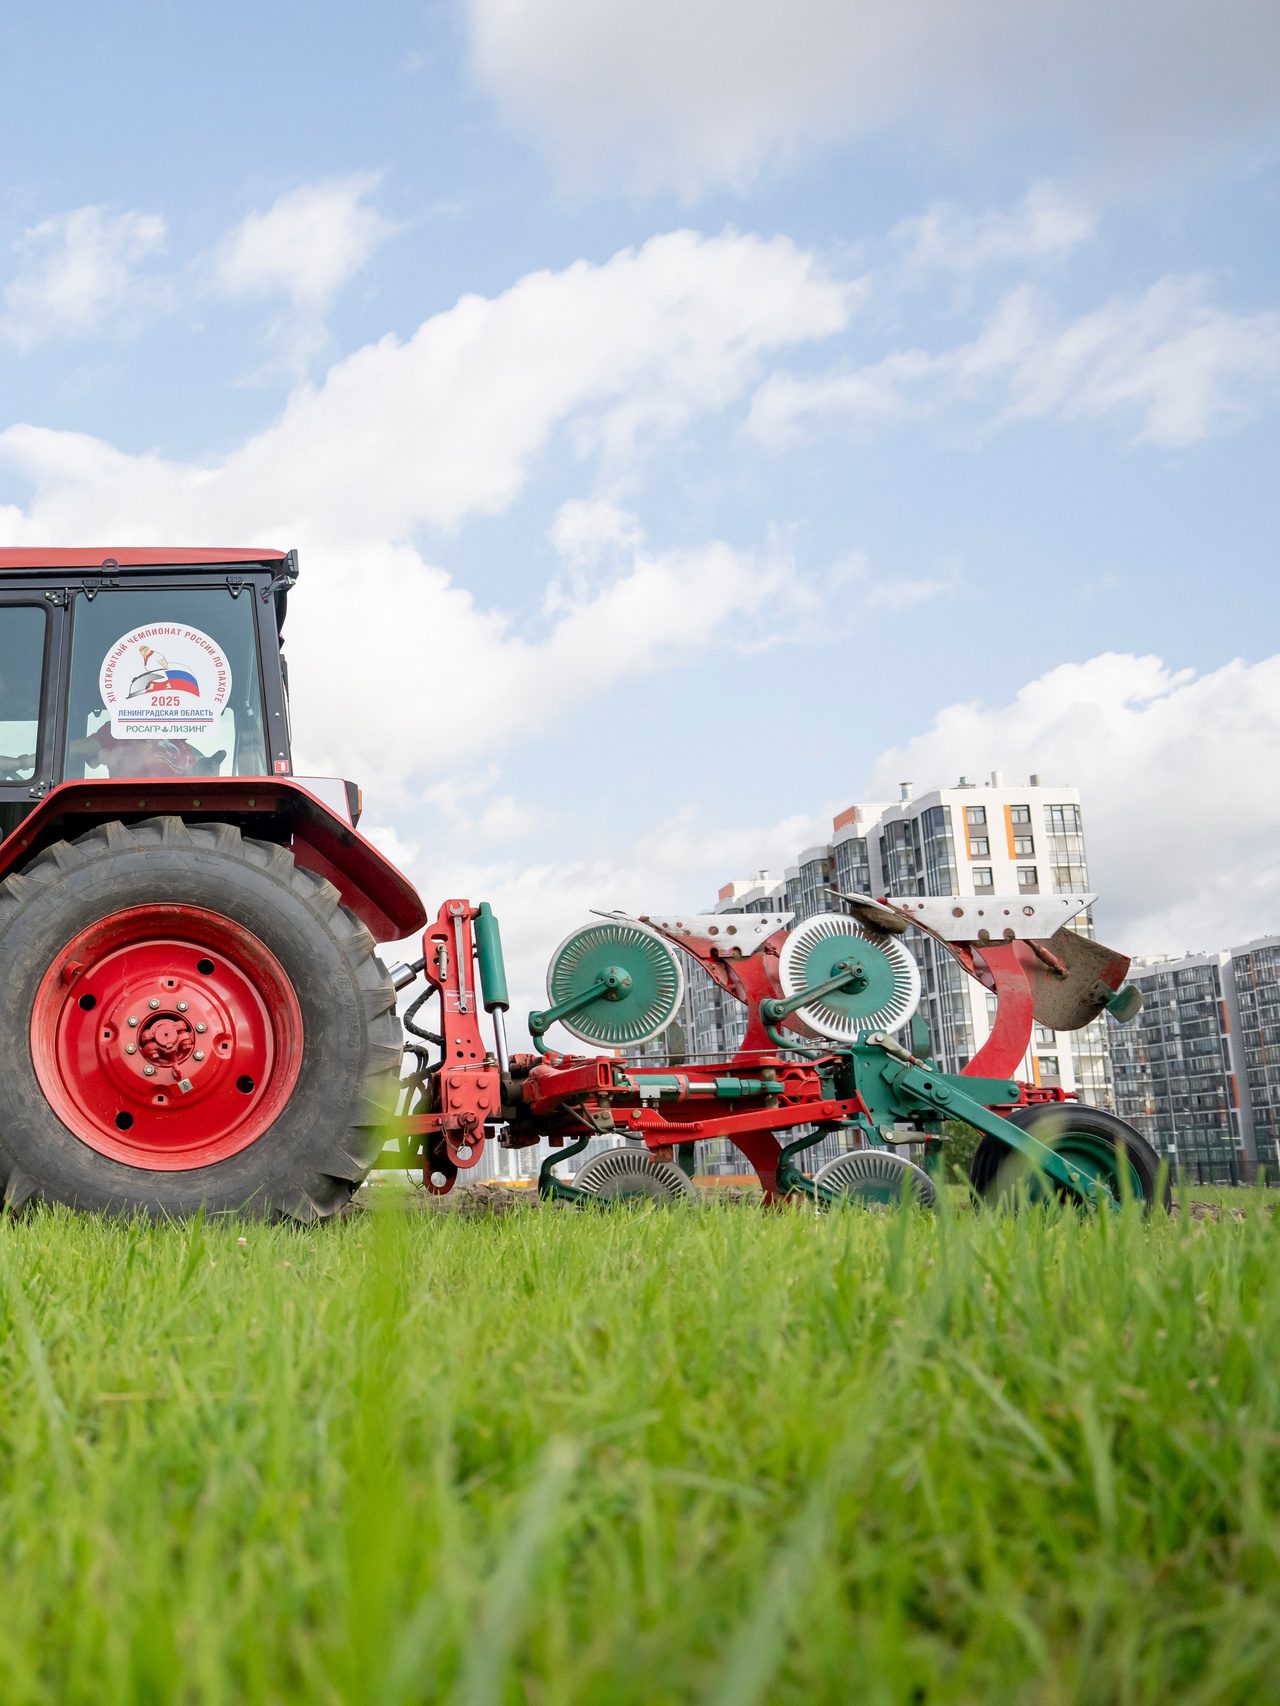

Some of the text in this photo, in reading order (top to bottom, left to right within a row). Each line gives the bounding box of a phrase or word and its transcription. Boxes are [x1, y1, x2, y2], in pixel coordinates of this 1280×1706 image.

[127, 627, 182, 644] ЧЕМПИОНАТ
[184, 631, 216, 656] РОССИИ
[104, 643, 128, 689] ОТКРЫТЫЙ
[213, 656, 223, 668] ПО
[214, 670, 226, 703] ПАХОТЕ
[151, 696, 180, 707] 2025
[118, 709, 214, 717] ЛЕНИНГРАДСКАЯ ОБЛАСТЬ
